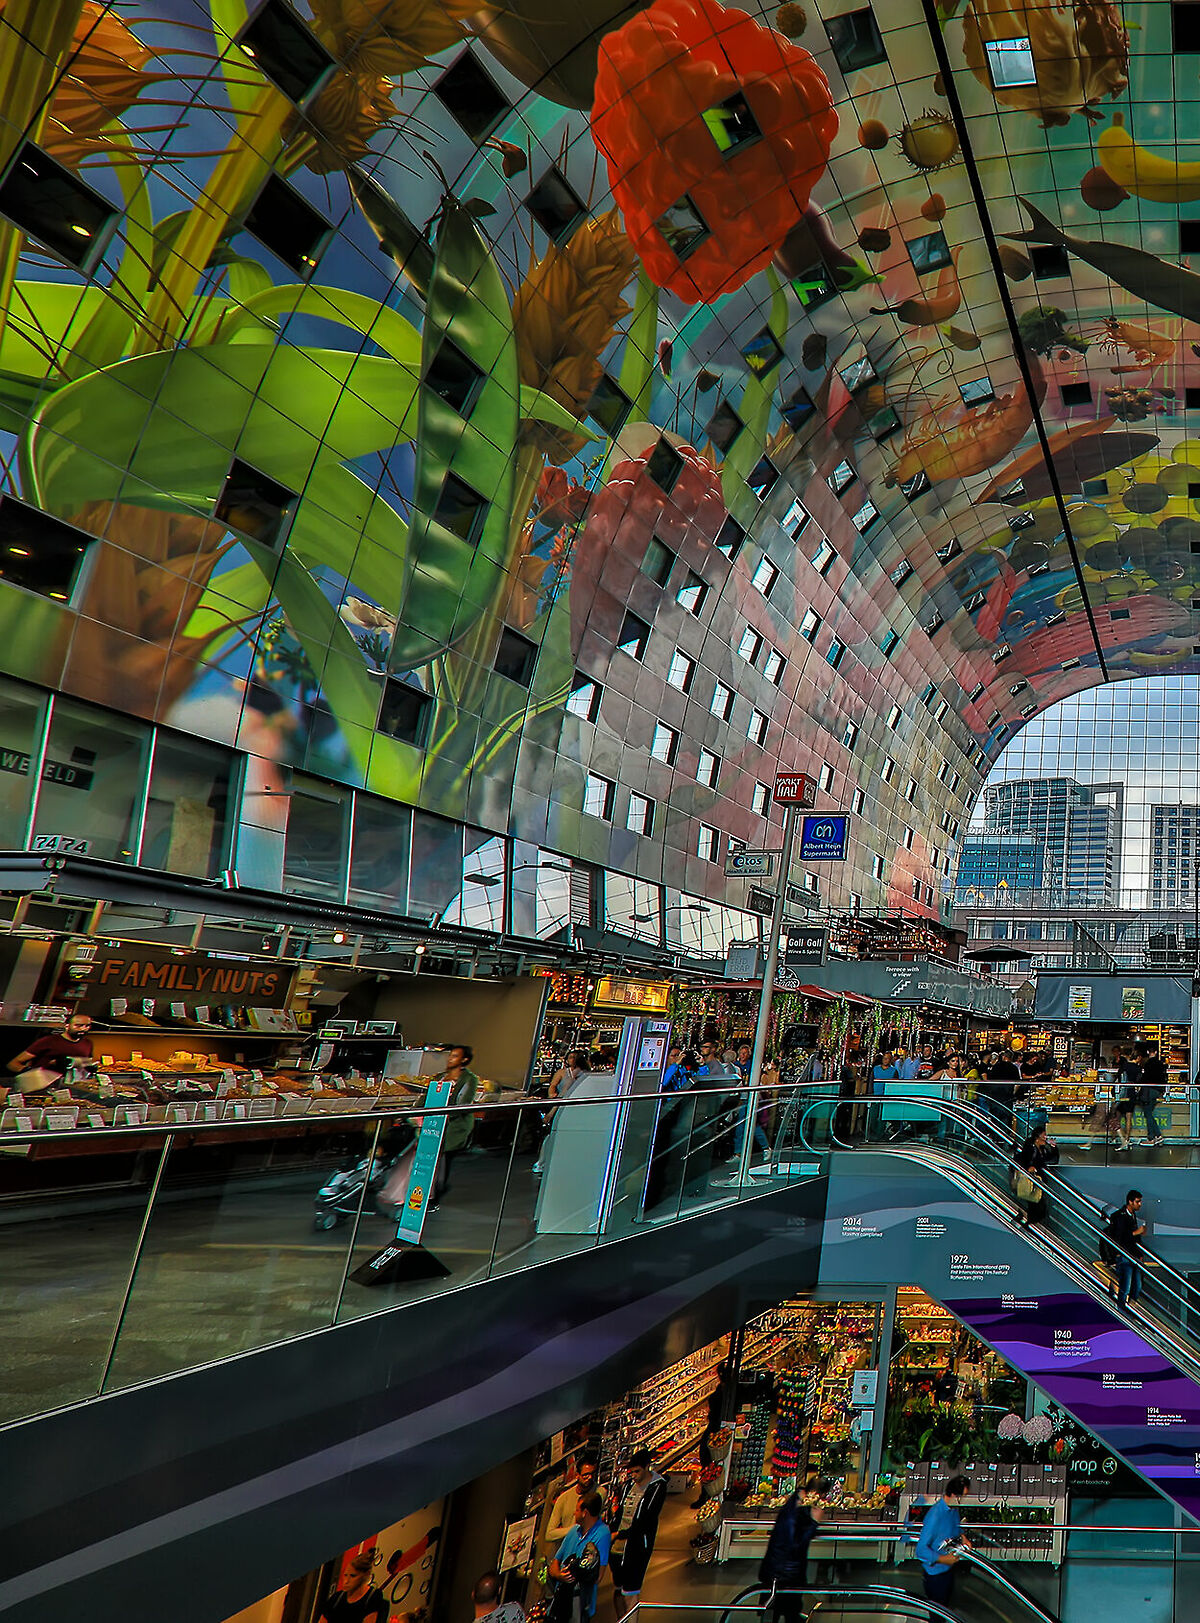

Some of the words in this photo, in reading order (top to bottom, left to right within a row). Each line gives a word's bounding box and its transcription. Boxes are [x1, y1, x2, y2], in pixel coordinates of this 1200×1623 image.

[2, 752, 76, 782] WEELD
[732, 855, 762, 869] etos
[100, 959, 211, 991] FAMILY
[211, 968, 279, 996] NUTS
[843, 1217, 862, 1226] 2014
[950, 1255, 969, 1264] 1972
[1053, 1330, 1072, 1339] 1940
